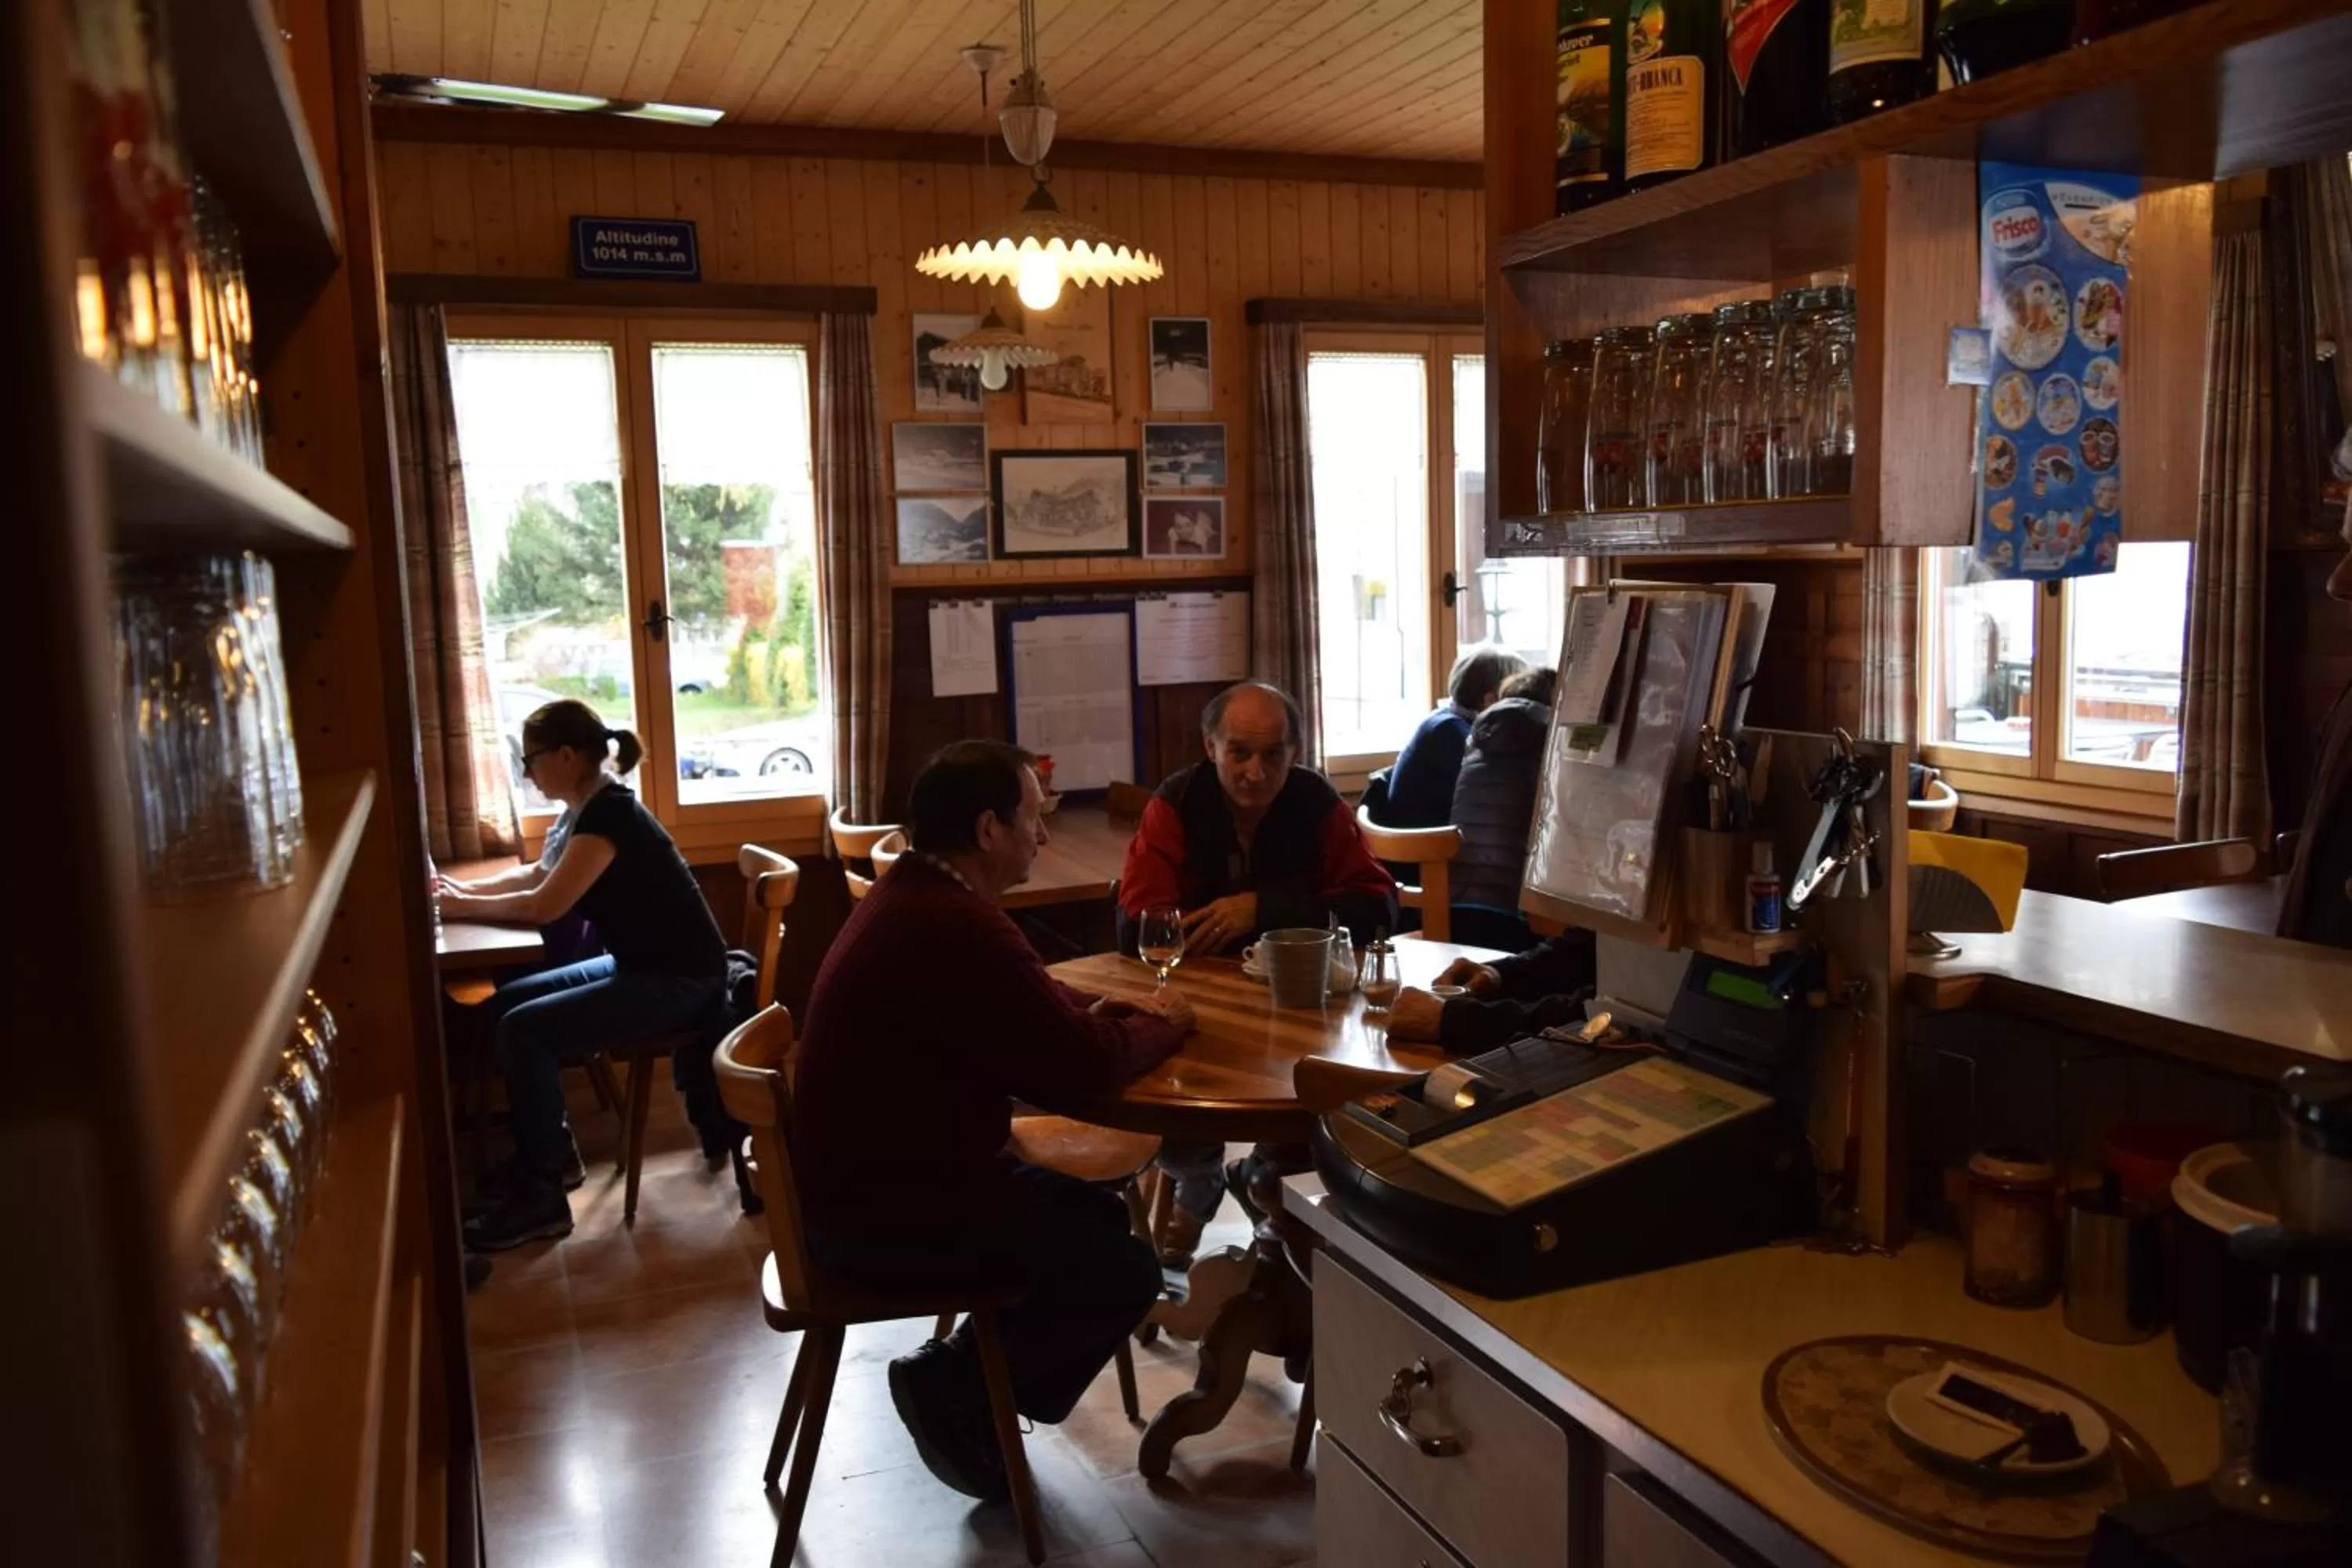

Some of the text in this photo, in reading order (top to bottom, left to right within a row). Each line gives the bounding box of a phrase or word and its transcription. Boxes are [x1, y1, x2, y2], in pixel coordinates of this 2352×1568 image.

[1992, 216, 2038, 243] Frisco
[595, 230, 679, 246] Altitudine
[592, 246, 628, 261] 1014
